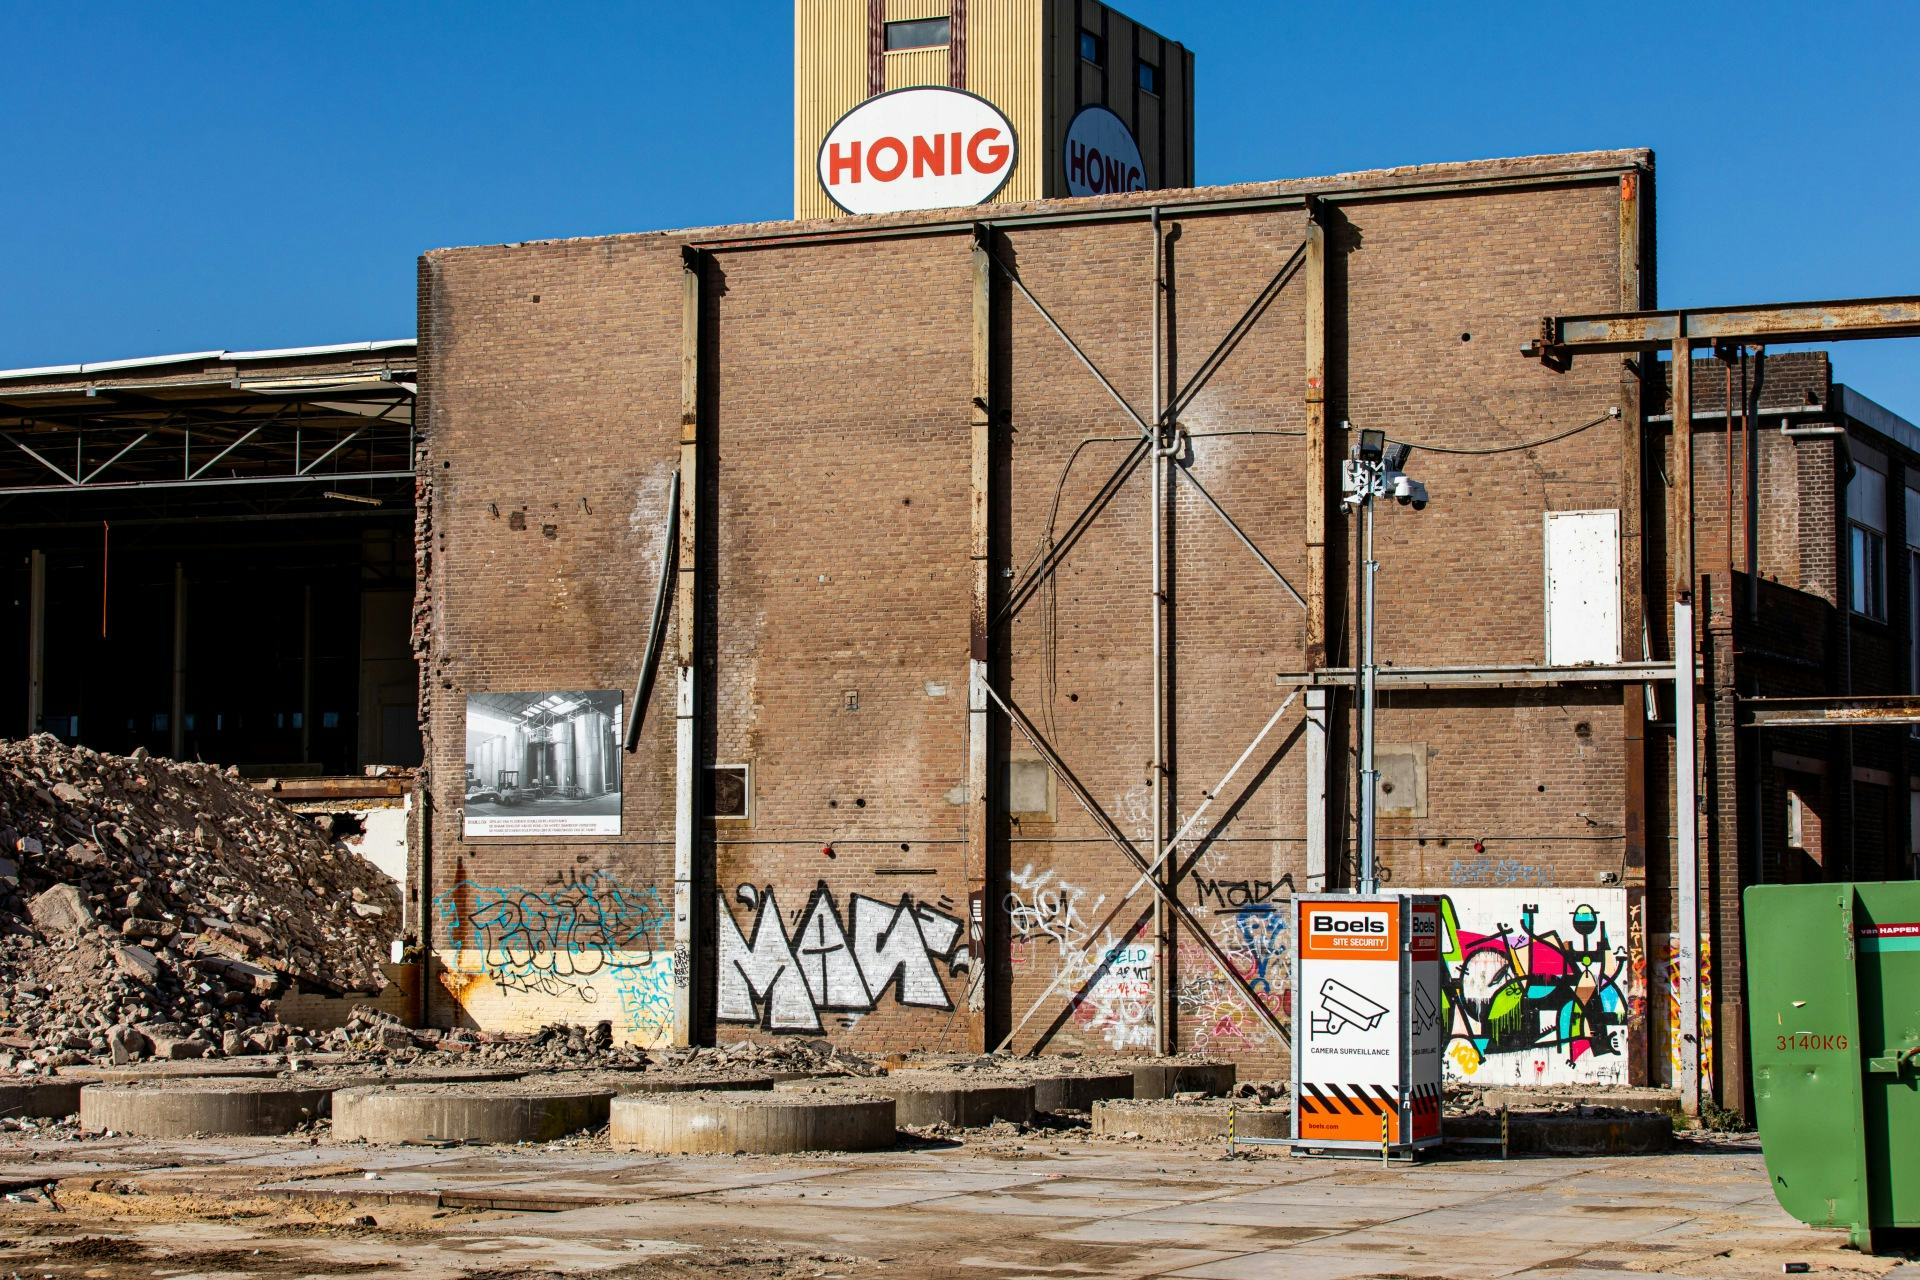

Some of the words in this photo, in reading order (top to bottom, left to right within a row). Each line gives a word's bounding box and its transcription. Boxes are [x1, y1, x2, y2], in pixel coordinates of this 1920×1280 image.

[829, 128, 1010, 186] HONIG
[1070, 139, 1143, 195] HONIG
[1313, 916, 1385, 933] Boels
[1412, 916, 1435, 933] Boels
[1879, 926, 1919, 934] HAPPEN
[1333, 937, 1348, 947] SITE
[1350, 938, 1385, 947] SECURITY
[1776, 1034, 1848, 1051] 3140KG
[1310, 1047, 1339, 1055] CAMERA
[1340, 1048, 1390, 1056] SURVEILLANCE
[1308, 1123, 1339, 1131] boels.com
